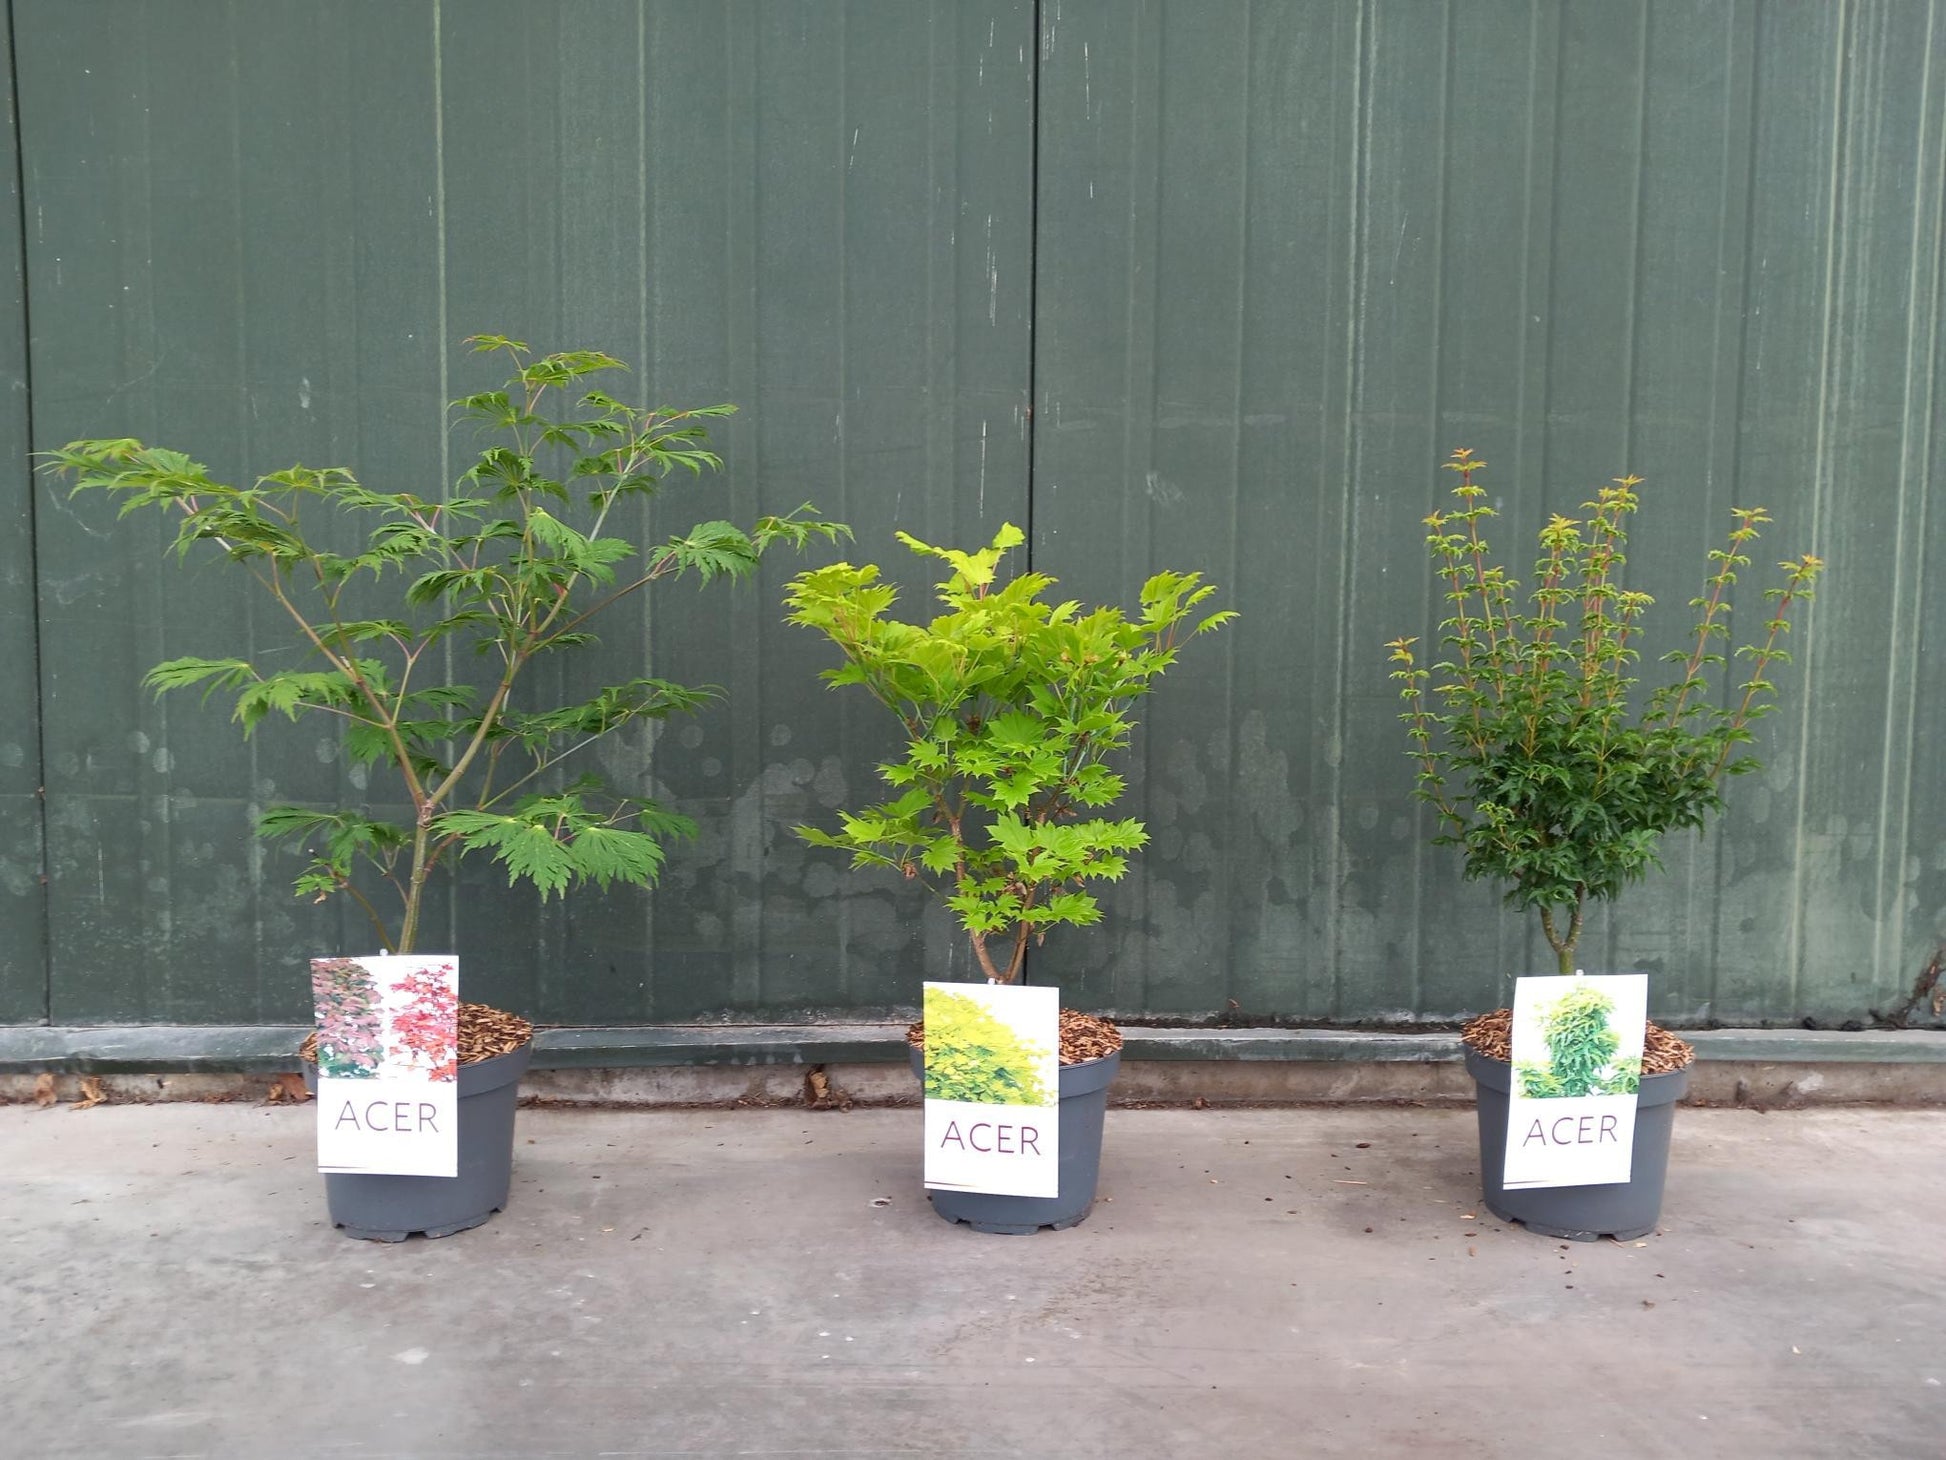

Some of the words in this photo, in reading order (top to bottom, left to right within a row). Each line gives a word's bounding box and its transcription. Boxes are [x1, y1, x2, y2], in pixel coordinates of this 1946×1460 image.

[335, 1100, 439, 1133] ACER
[1522, 1114, 1618, 1147] ACER
[940, 1120, 1041, 1156] ACER
